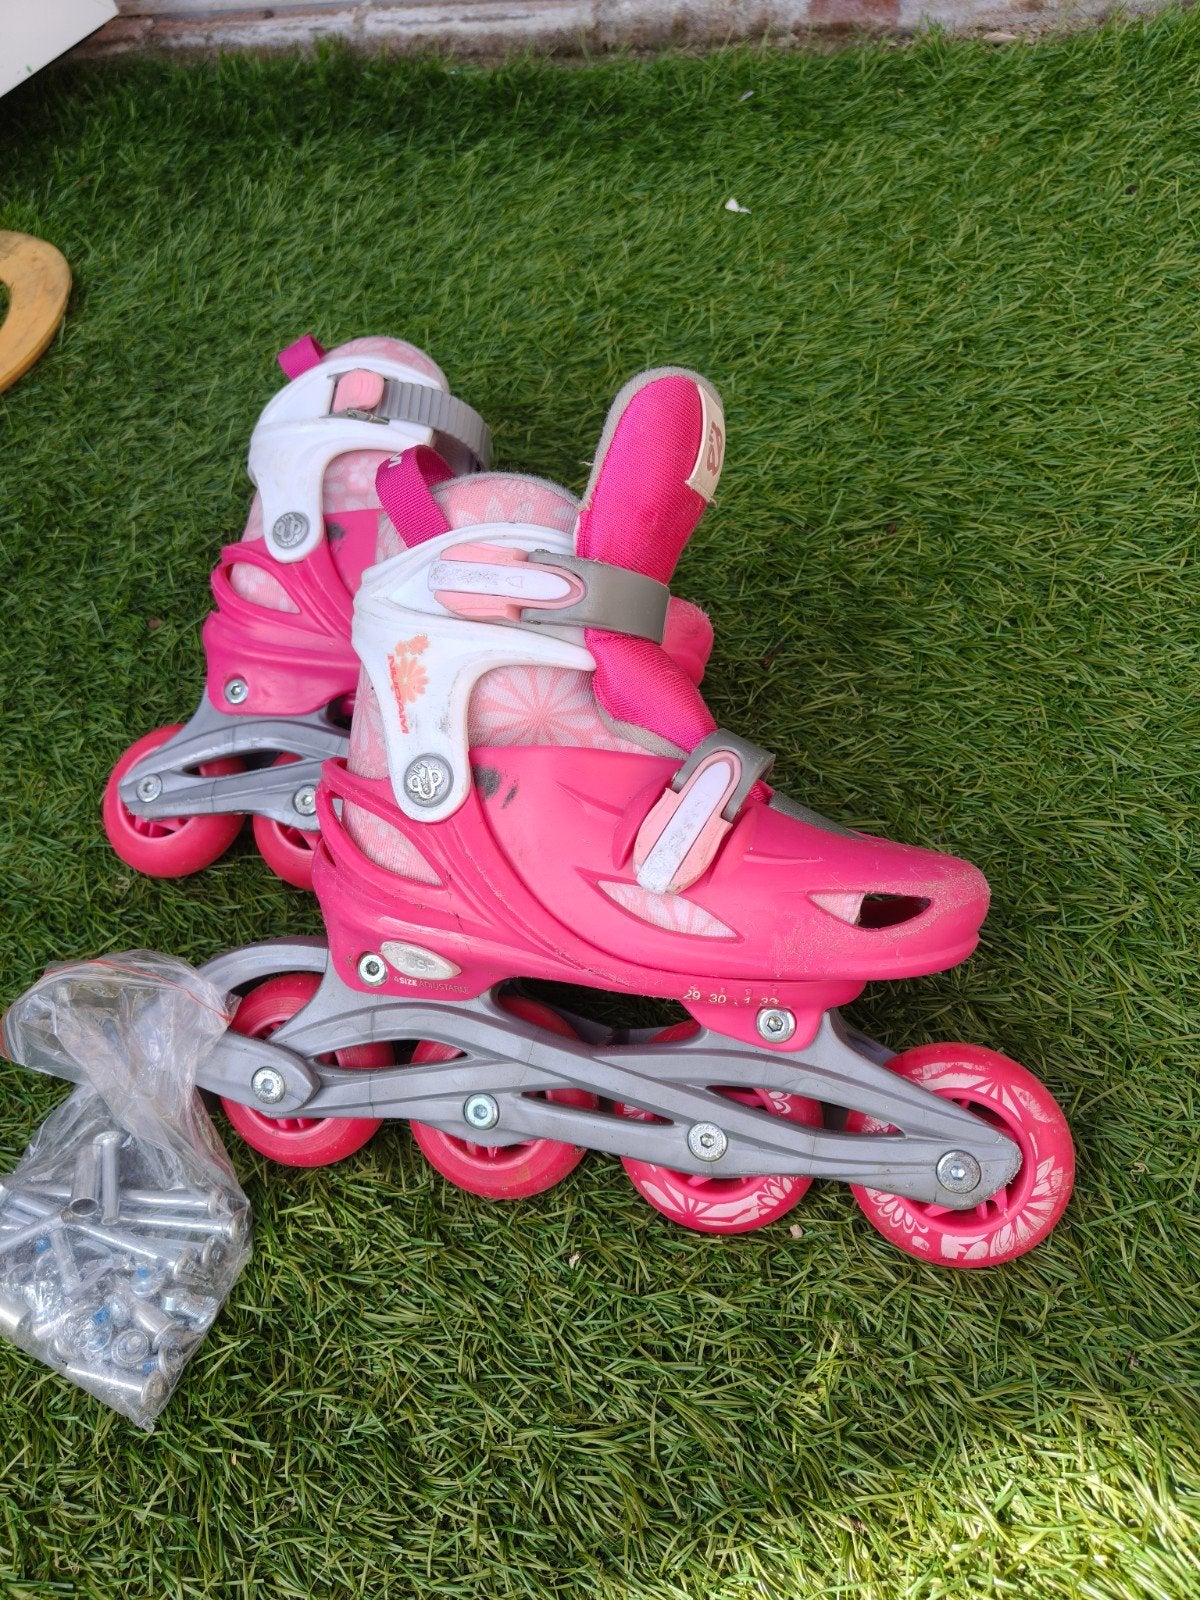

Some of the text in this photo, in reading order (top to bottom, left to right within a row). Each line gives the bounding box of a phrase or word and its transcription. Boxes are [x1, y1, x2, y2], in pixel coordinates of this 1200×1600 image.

[420, 980, 469, 994] ADJUSTABLE
[683, 989, 701, 1001] 29
[708, 993, 727, 1004] 30
